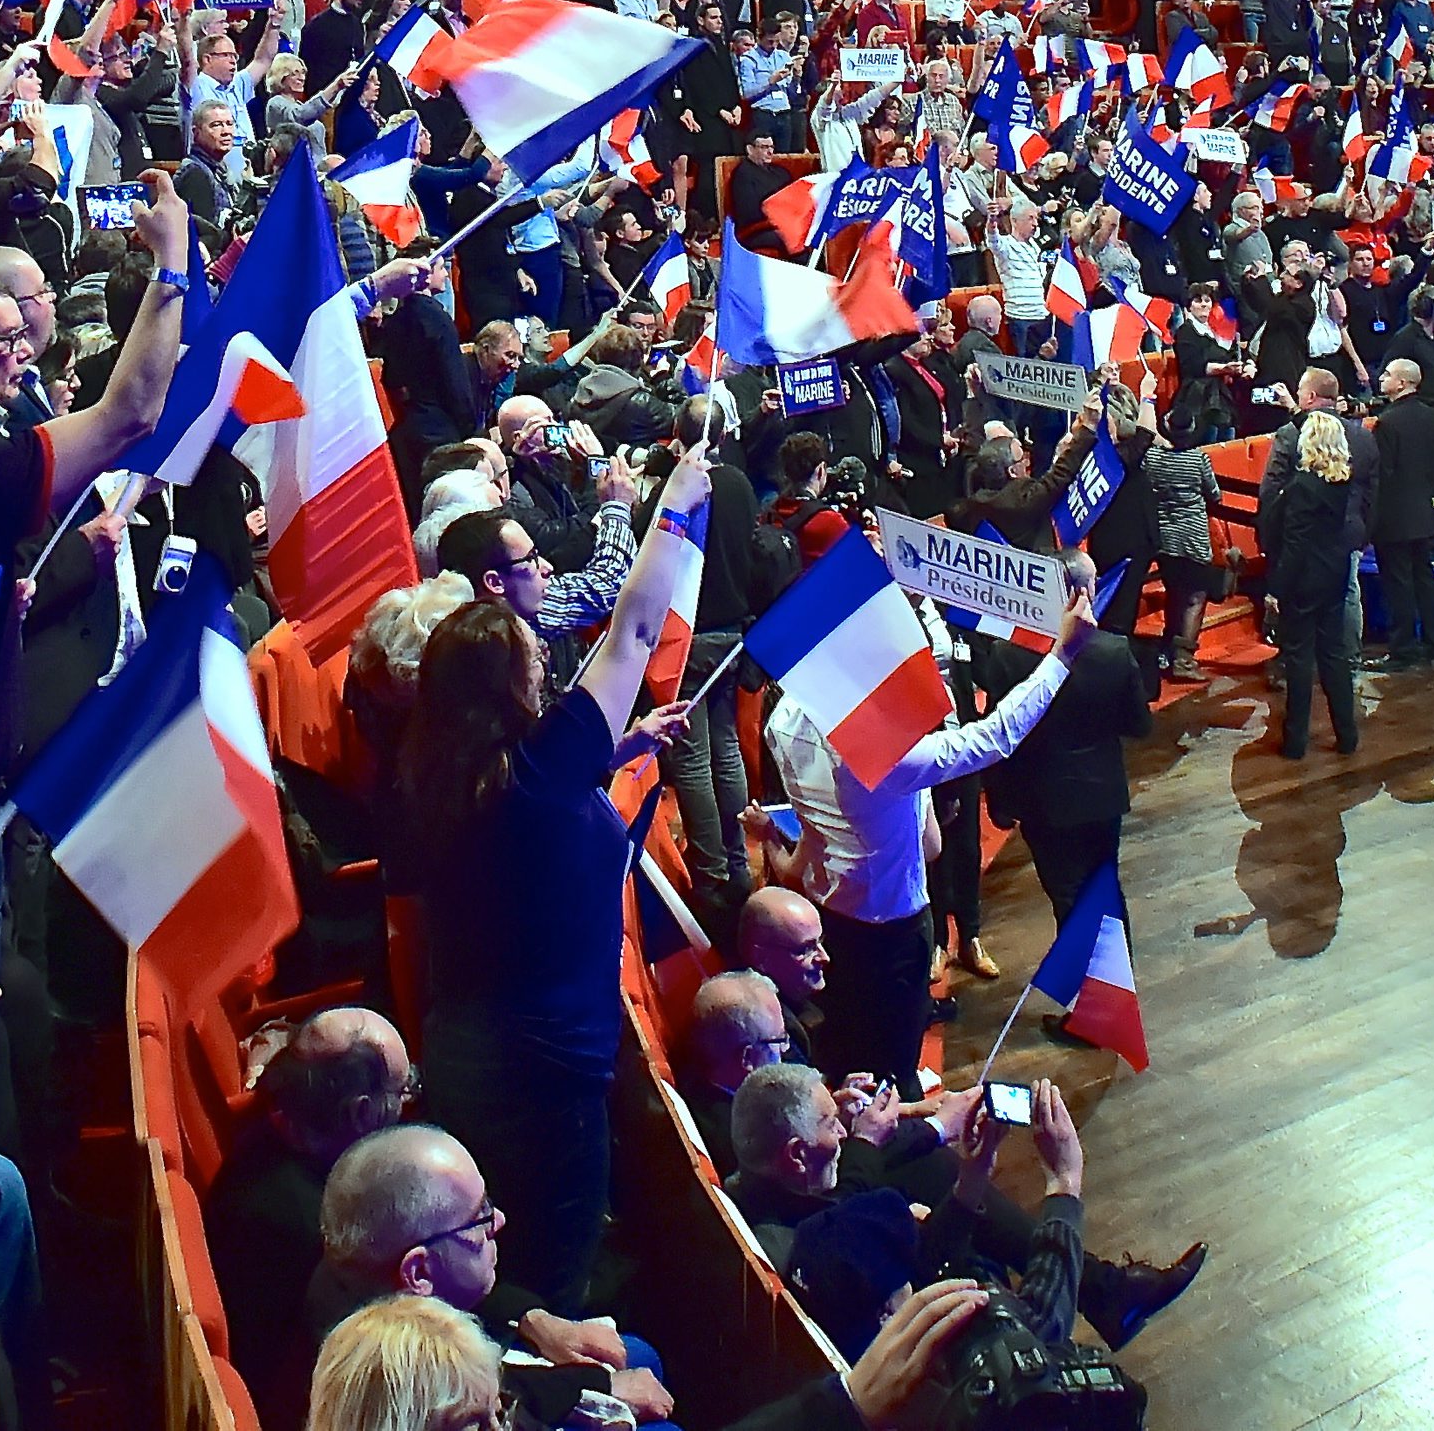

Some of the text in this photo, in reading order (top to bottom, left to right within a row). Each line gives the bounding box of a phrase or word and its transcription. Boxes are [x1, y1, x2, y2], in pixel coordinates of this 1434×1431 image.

[857, 52, 898, 65] MARINE
[1005, 361, 1076, 389] MARINE
[795, 380, 835, 404] MARINE
[1007, 381, 1076, 406] Présidente
[927, 533, 1046, 594] MARINE
[927, 568, 1044, 623] Présidente
